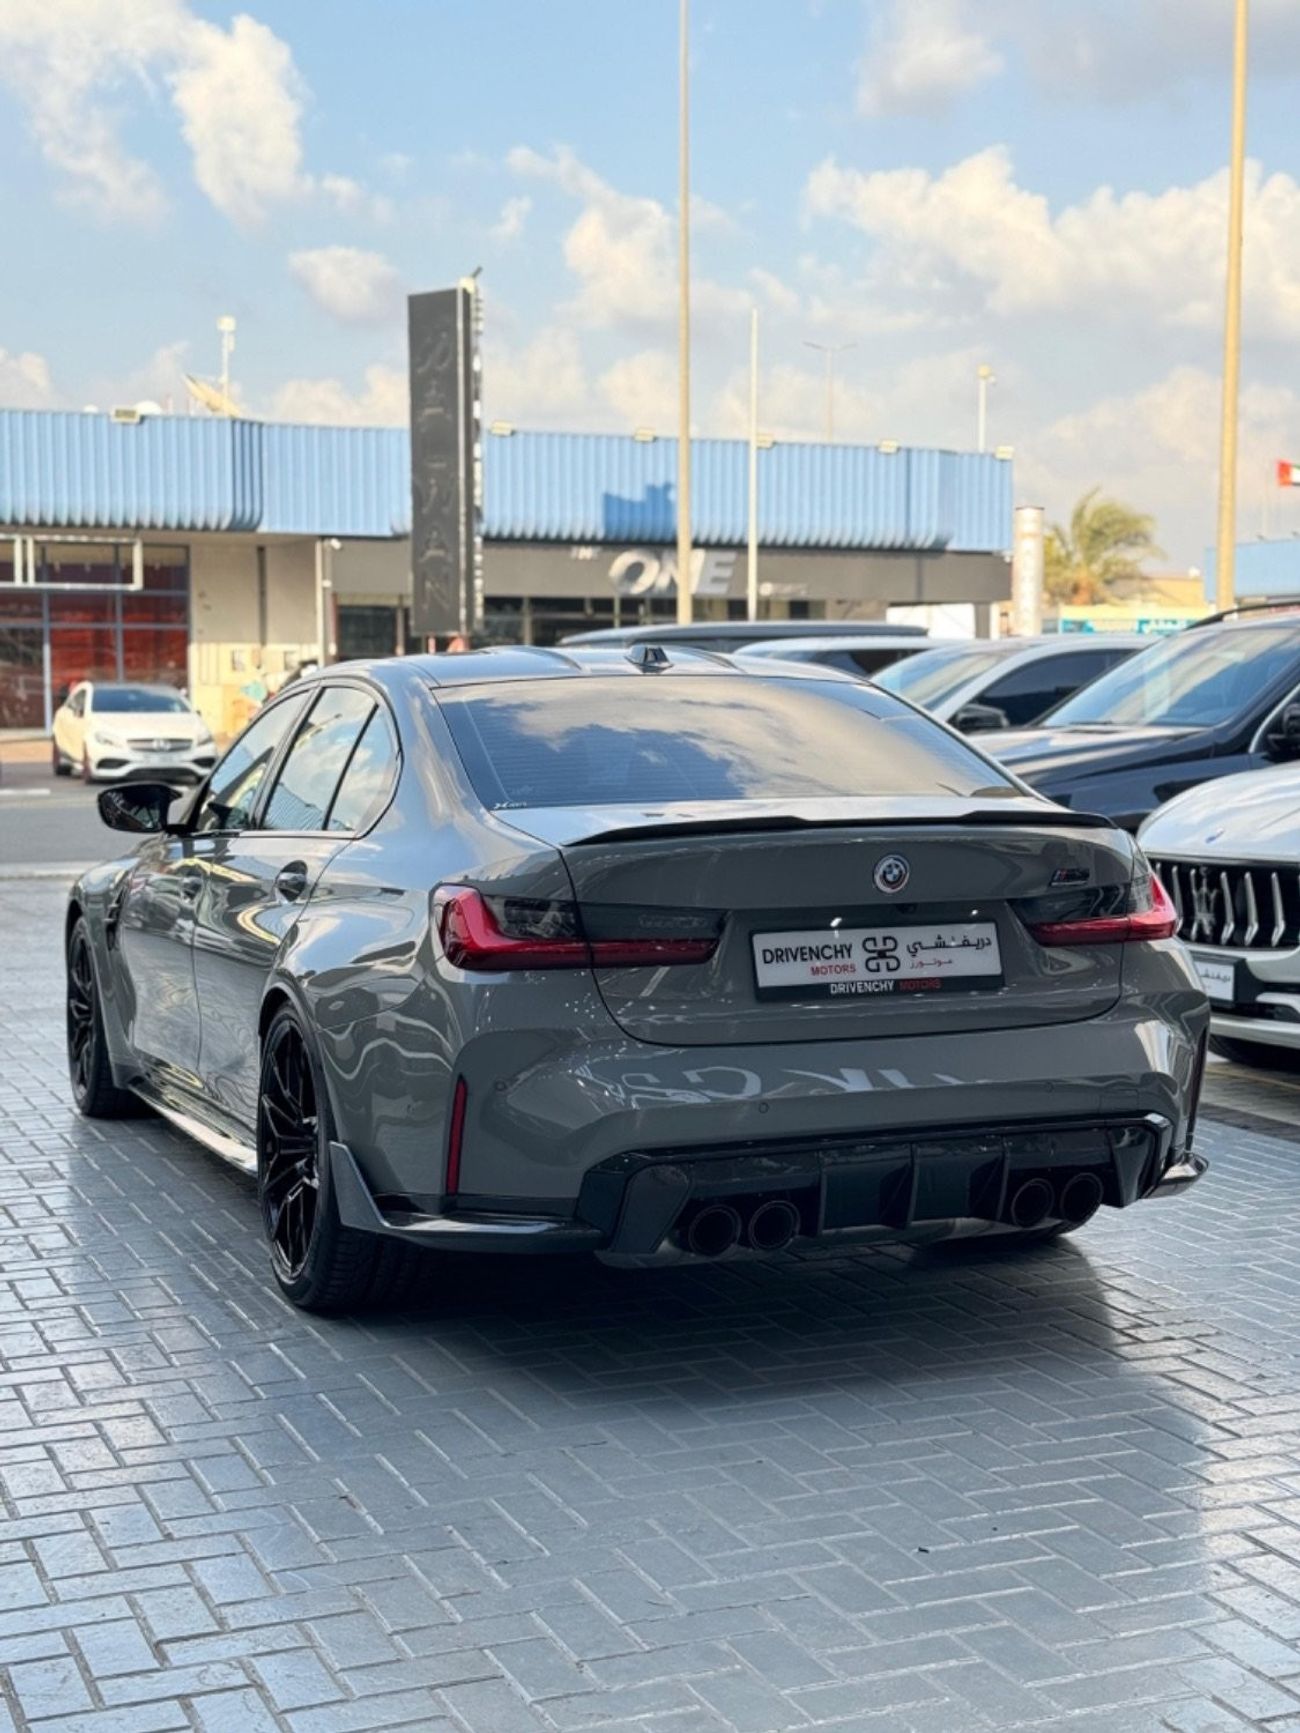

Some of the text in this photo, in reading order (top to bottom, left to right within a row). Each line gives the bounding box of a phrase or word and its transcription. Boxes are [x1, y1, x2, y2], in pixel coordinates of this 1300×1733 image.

[608, 549, 736, 595] ONE
[762, 944, 853, 965] DRIVENCHY
[810, 963, 856, 977] MOTORS
[830, 977, 942, 994] DRIVENCHY MOTORS
